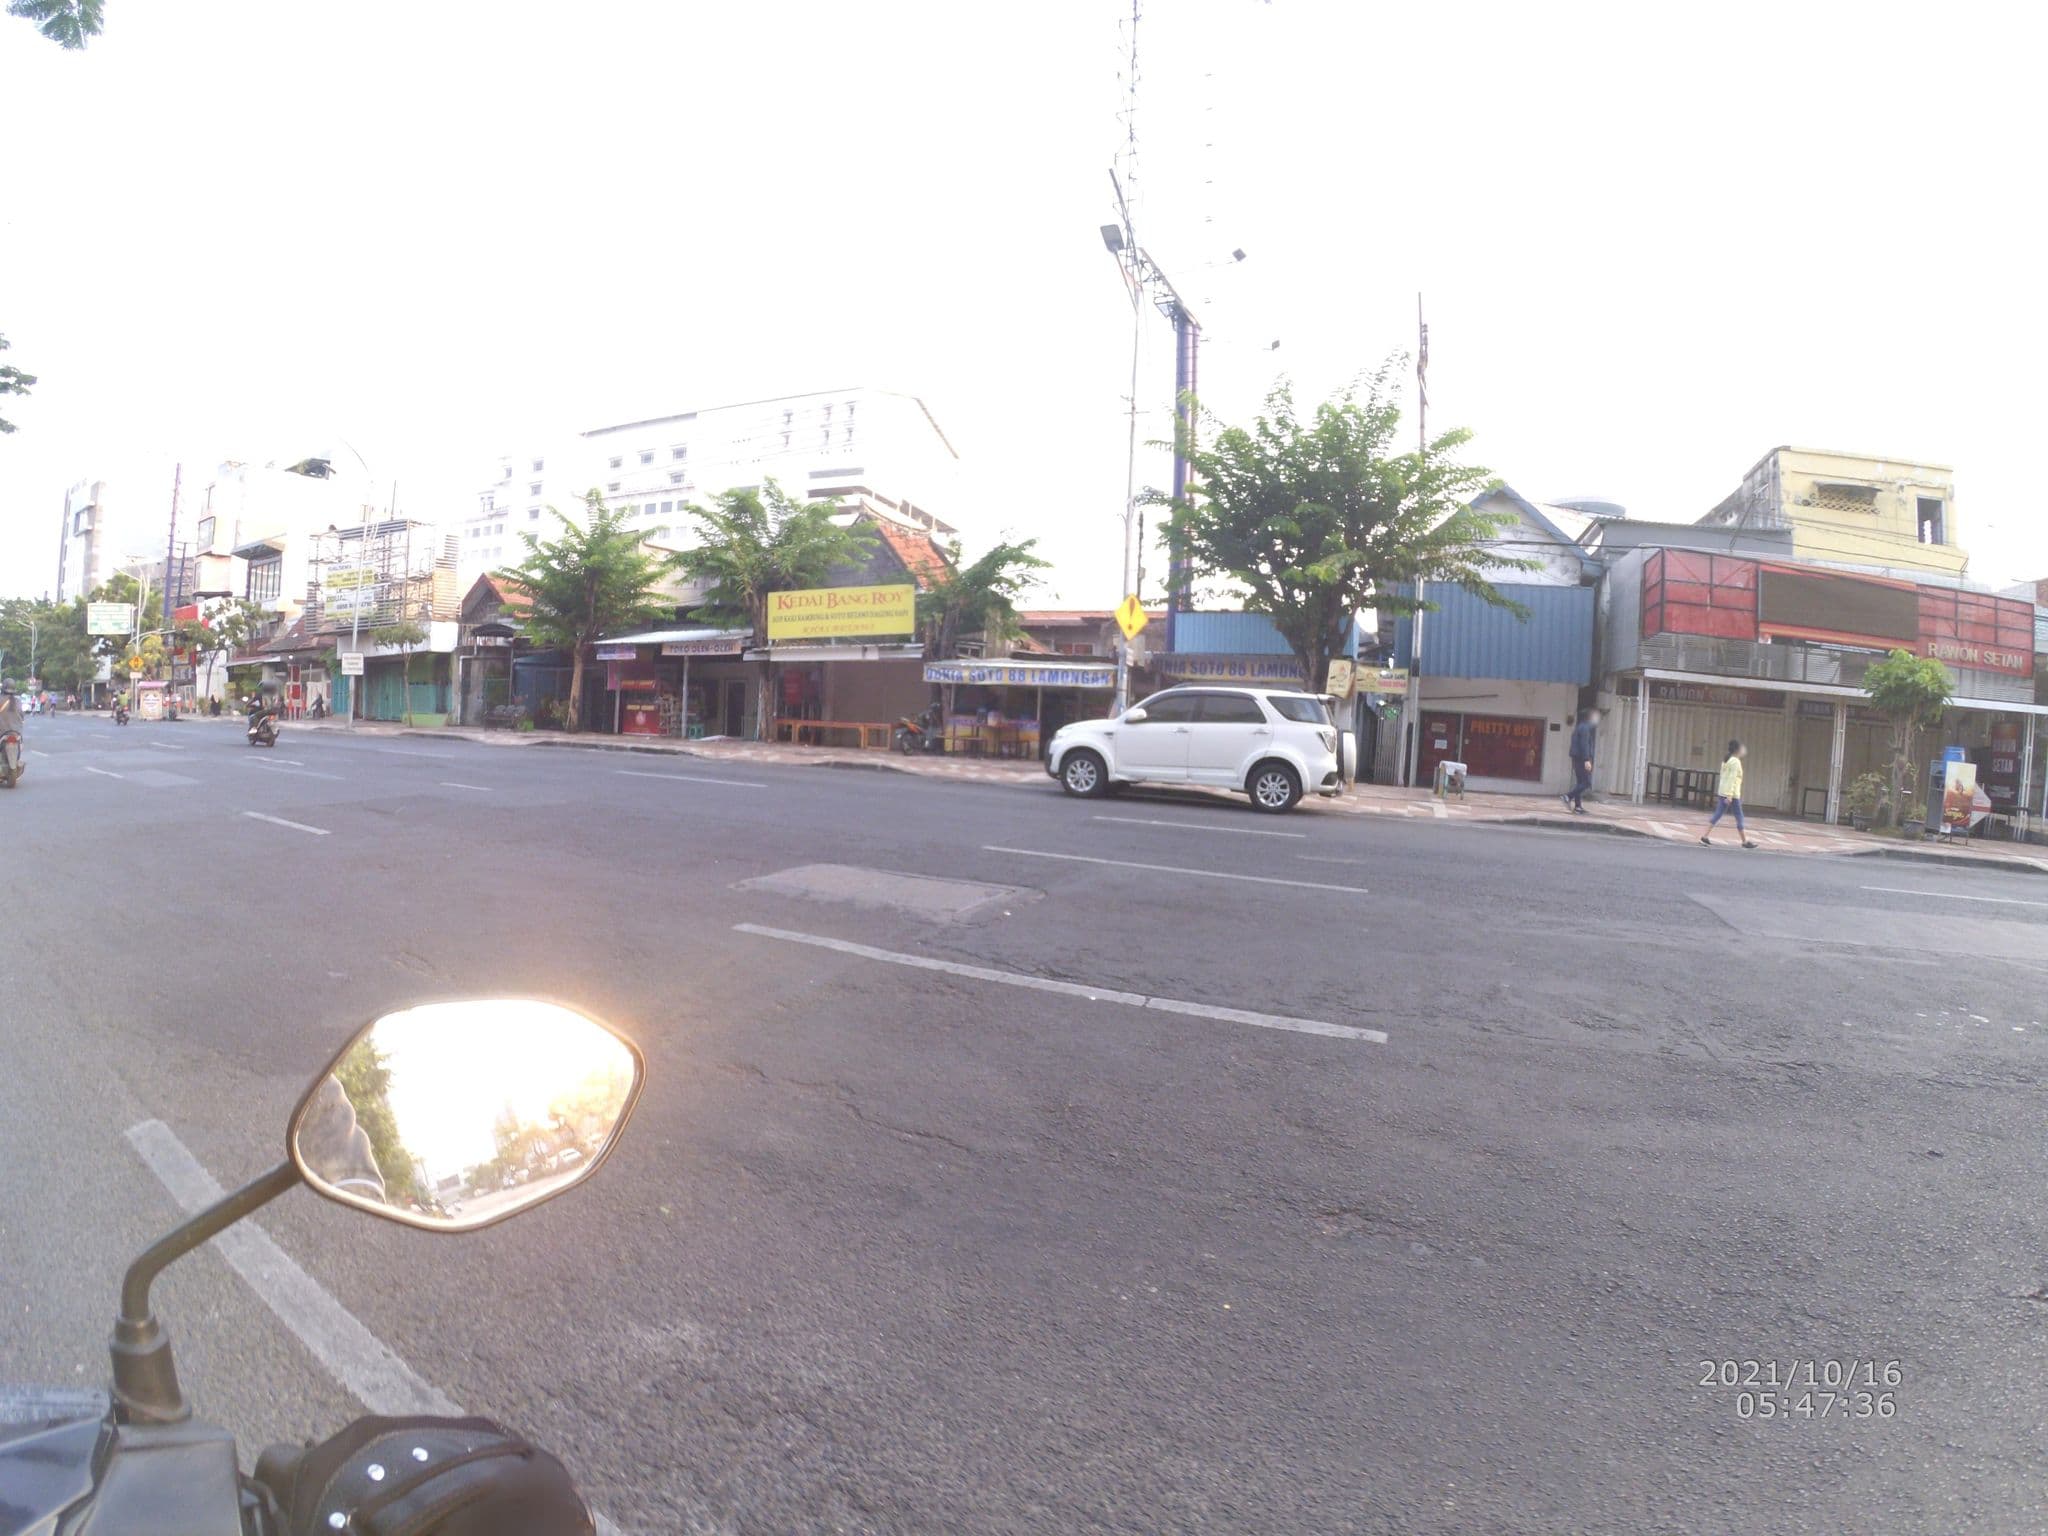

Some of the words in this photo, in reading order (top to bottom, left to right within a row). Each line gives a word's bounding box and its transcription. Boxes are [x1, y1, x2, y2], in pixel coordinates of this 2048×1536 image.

[778, 594, 822, 610] KEDAI
[827, 592, 868, 609] BANG
[872, 590, 903, 605] ROY
[1928, 642, 1978, 663] RAWON
[1984, 650, 2023, 669] SETAN
[926, 668, 964, 682] DUNIA
[969, 669, 1004, 682] SOTO
[1008, 669, 1026, 682] 88
[1031, 671, 1109, 685] LAMONGAN
[1190, 661, 1225, 676] SOTO
[1660, 686, 1705, 701] RAWON
